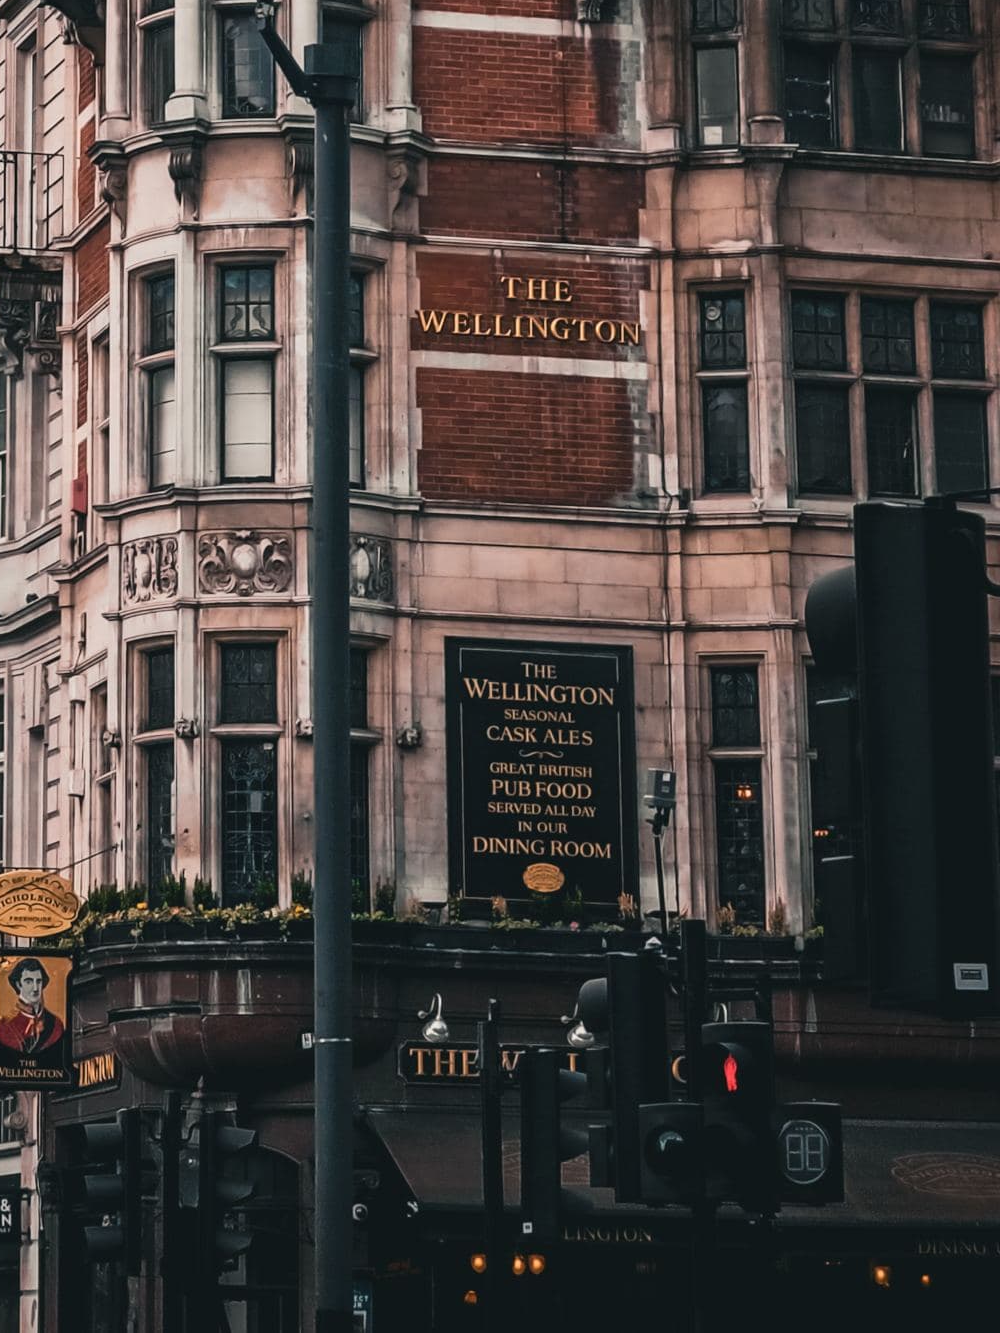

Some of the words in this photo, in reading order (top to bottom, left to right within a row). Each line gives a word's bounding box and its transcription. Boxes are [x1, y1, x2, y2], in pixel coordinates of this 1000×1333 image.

[500, 276, 573, 302] THE
[416, 309, 640, 344] WELLINGTON
[520, 661, 557, 679] THE
[463, 677, 615, 705] WELLINGTON
[504, 708, 576, 723] SEASONAL
[486, 725, 537, 743] CASK
[544, 729, 593, 746] ALES
[489, 762, 535, 775] GREAT
[539, 764, 592, 778] BRITISH
[491, 779, 531, 797] PUB
[535, 782, 592, 799] FOOD
[488, 802, 541, 815] SERVED
[544, 805, 568, 816] ALL
[571, 805, 597, 817] DAY
[518, 821, 532, 832] IN
[537, 822, 568, 834] OUR
[472, 836, 545, 855] DINING
[551, 840, 611, 858] ROOM
[18, 1059, 37, 1067] THE
[409, 1048, 480, 1077] THE
[0, 1198, 11, 1212] &
